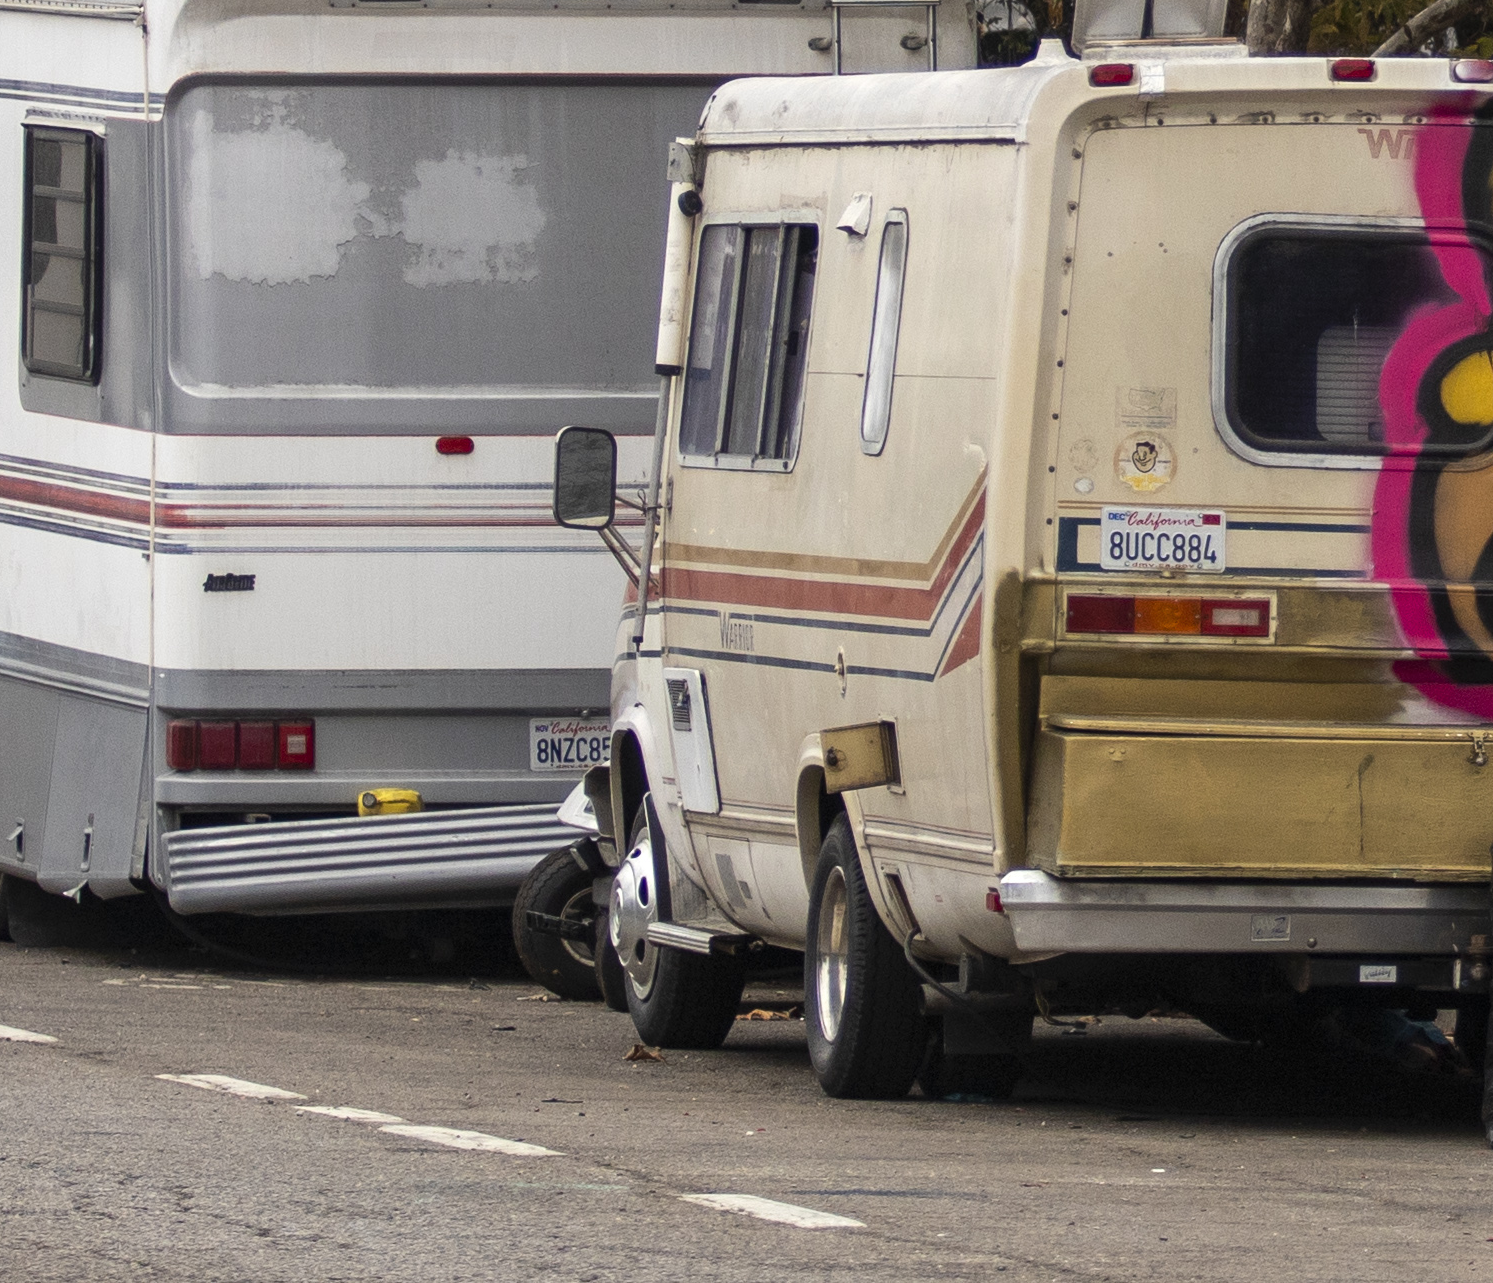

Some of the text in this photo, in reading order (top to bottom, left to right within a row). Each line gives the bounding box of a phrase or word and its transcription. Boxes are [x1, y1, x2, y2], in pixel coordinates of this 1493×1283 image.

[1127, 511, 1203, 530] California
[1110, 531, 1217, 564] 8UCC884
[551, 721, 611, 737] California
